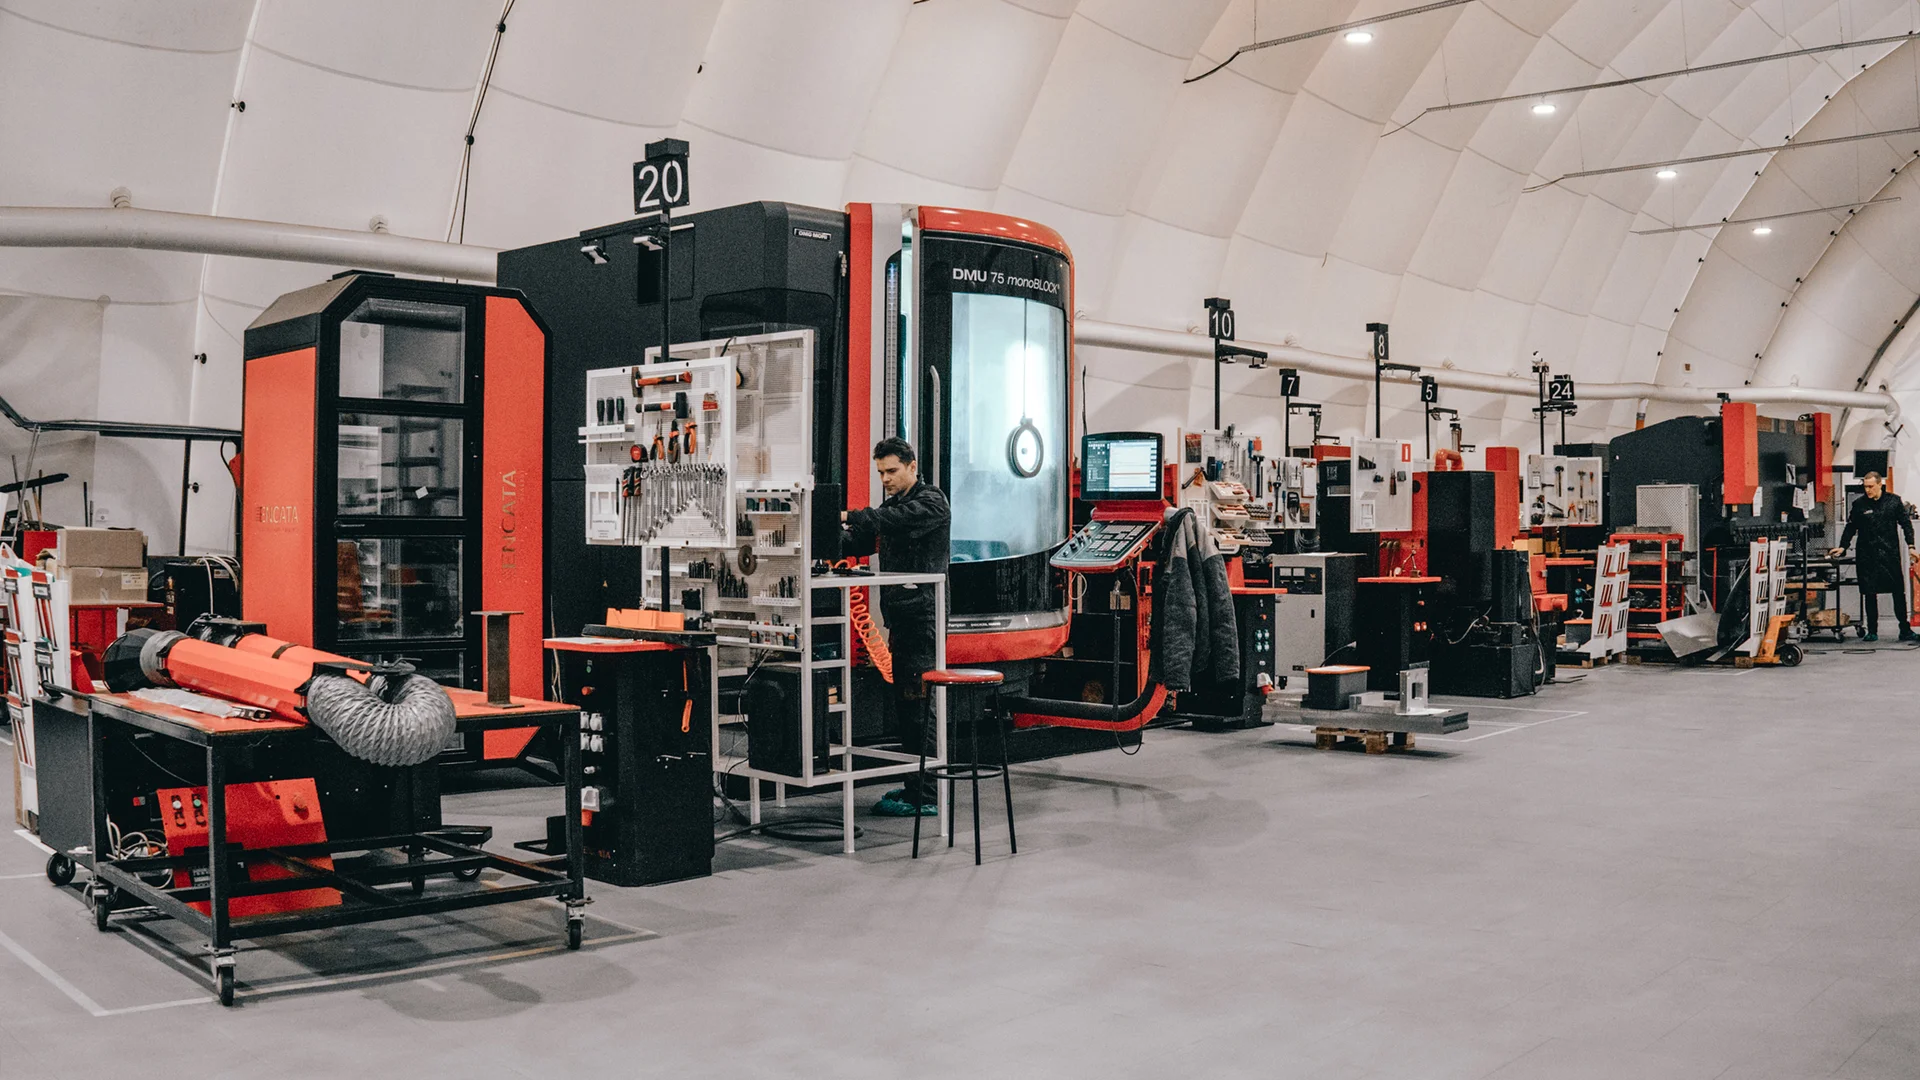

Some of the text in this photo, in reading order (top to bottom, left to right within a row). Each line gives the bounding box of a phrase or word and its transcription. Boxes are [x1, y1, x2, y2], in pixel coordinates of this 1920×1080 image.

[639, 160, 682, 208] 20
[952, 267, 988, 283] DMU
[990, 271, 1005, 285] 75
[1212, 310, 1232, 337] 10
[1378, 334, 1385, 357] 8
[1287, 376, 1295, 394] 7
[1425, 384, 1433, 401] 5
[1551, 382, 1572, 399] 24
[257, 505, 299, 523] ENCATA
[501, 470, 516, 570] ENCATA
